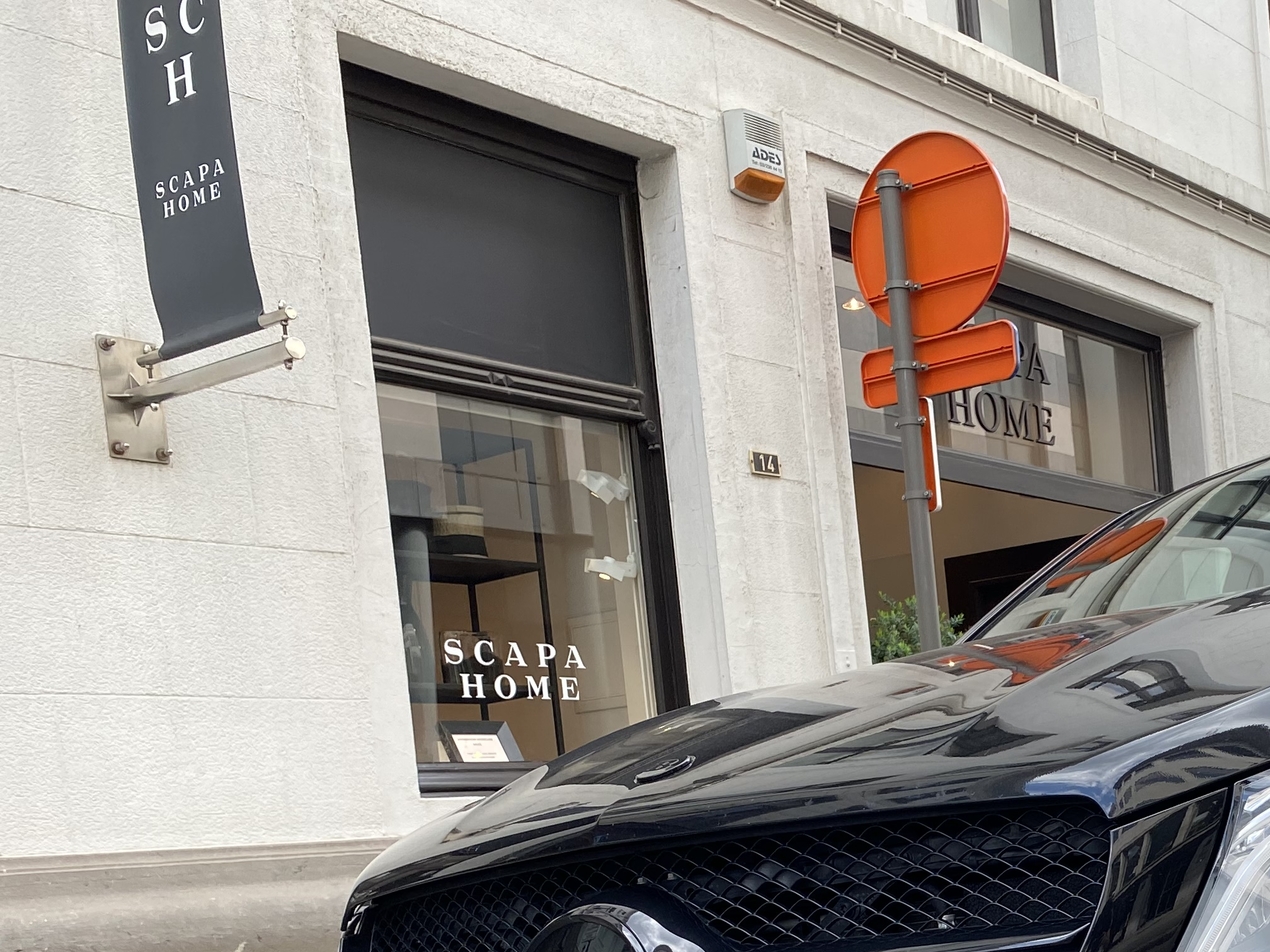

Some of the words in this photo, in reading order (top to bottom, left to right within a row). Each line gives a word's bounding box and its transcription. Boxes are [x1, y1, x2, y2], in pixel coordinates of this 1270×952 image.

[163, 52, 197, 106] H
[752, 146, 782, 167] ADES
[155, 158, 225, 199] SCAPA
[163, 181, 222, 219] HOME
[947, 387, 1056, 446] HOME
[758, 453, 776, 473] 14
[443, 638, 587, 670] SCAPA
[459, 673, 581, 701] HOME
